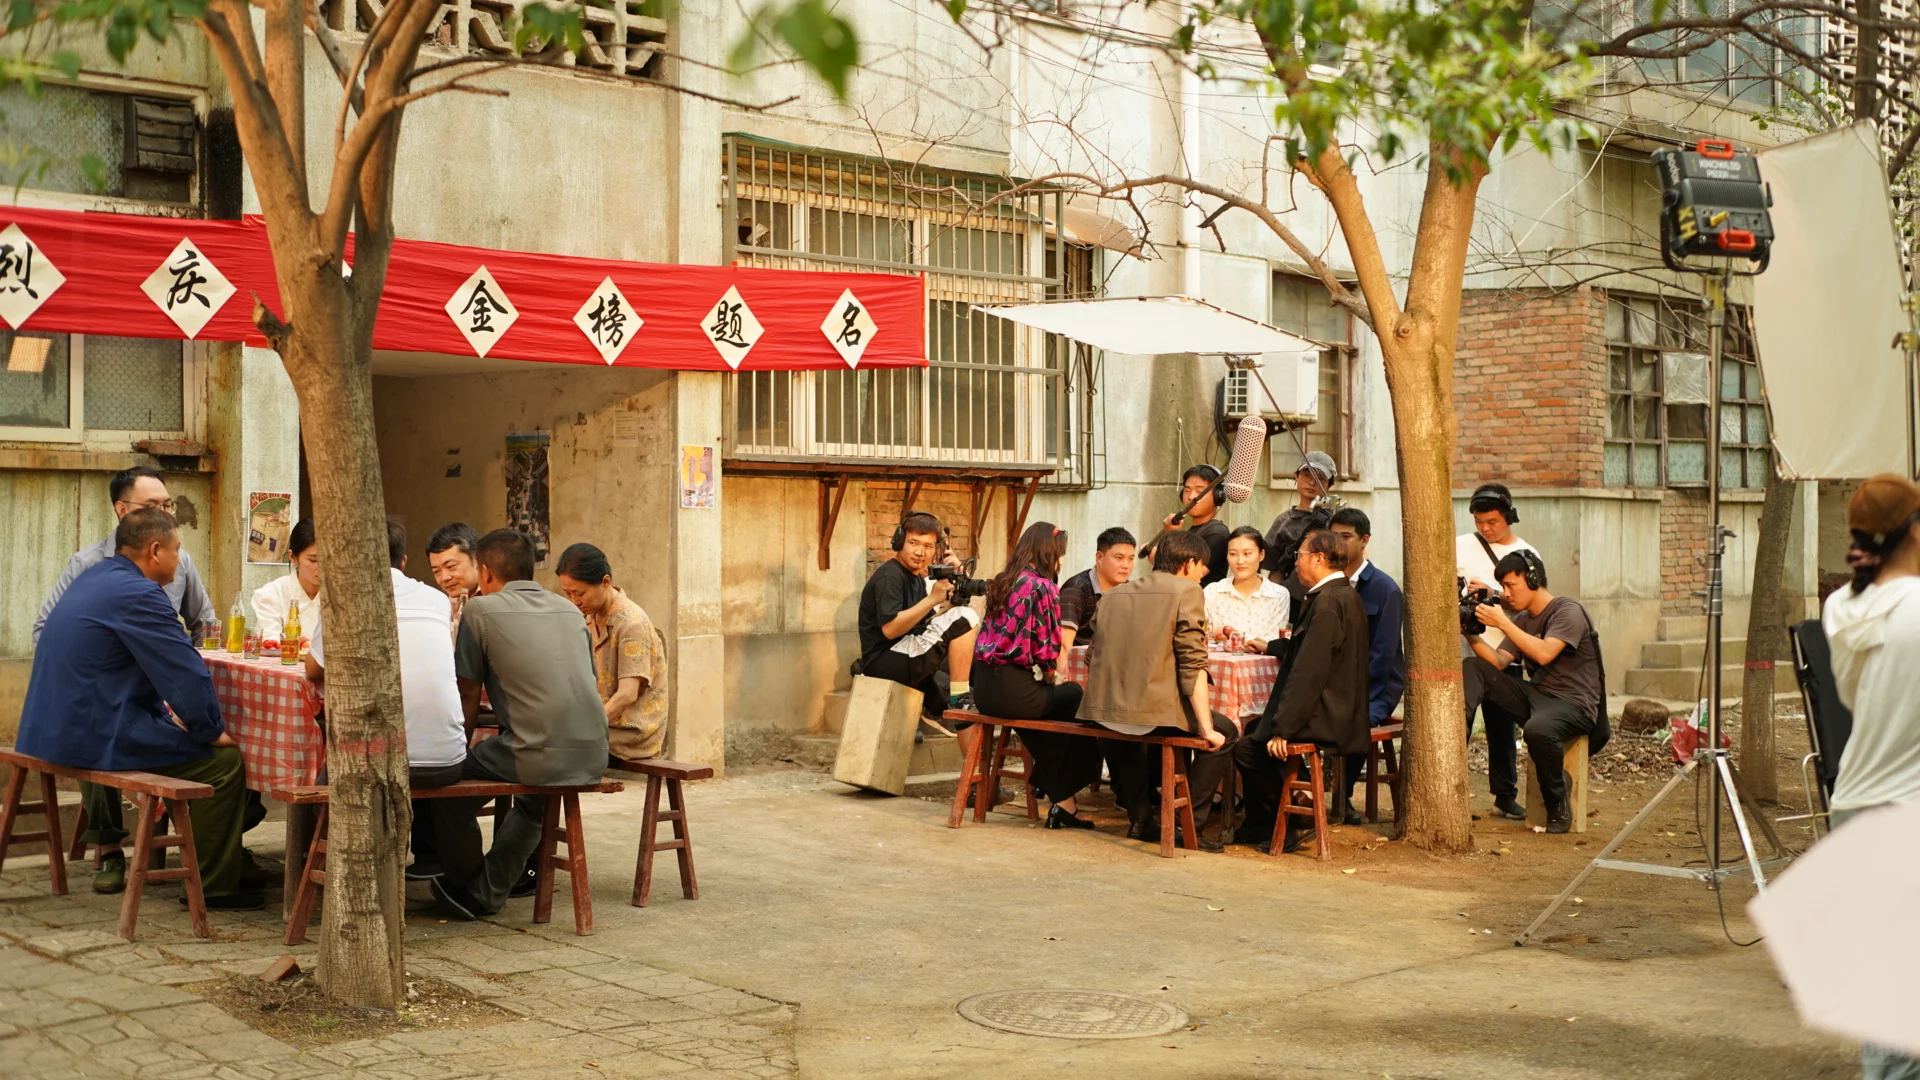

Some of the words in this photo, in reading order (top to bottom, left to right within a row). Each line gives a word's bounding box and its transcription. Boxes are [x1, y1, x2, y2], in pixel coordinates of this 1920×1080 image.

[0, 241, 861, 348] 烈庆金榜题名
